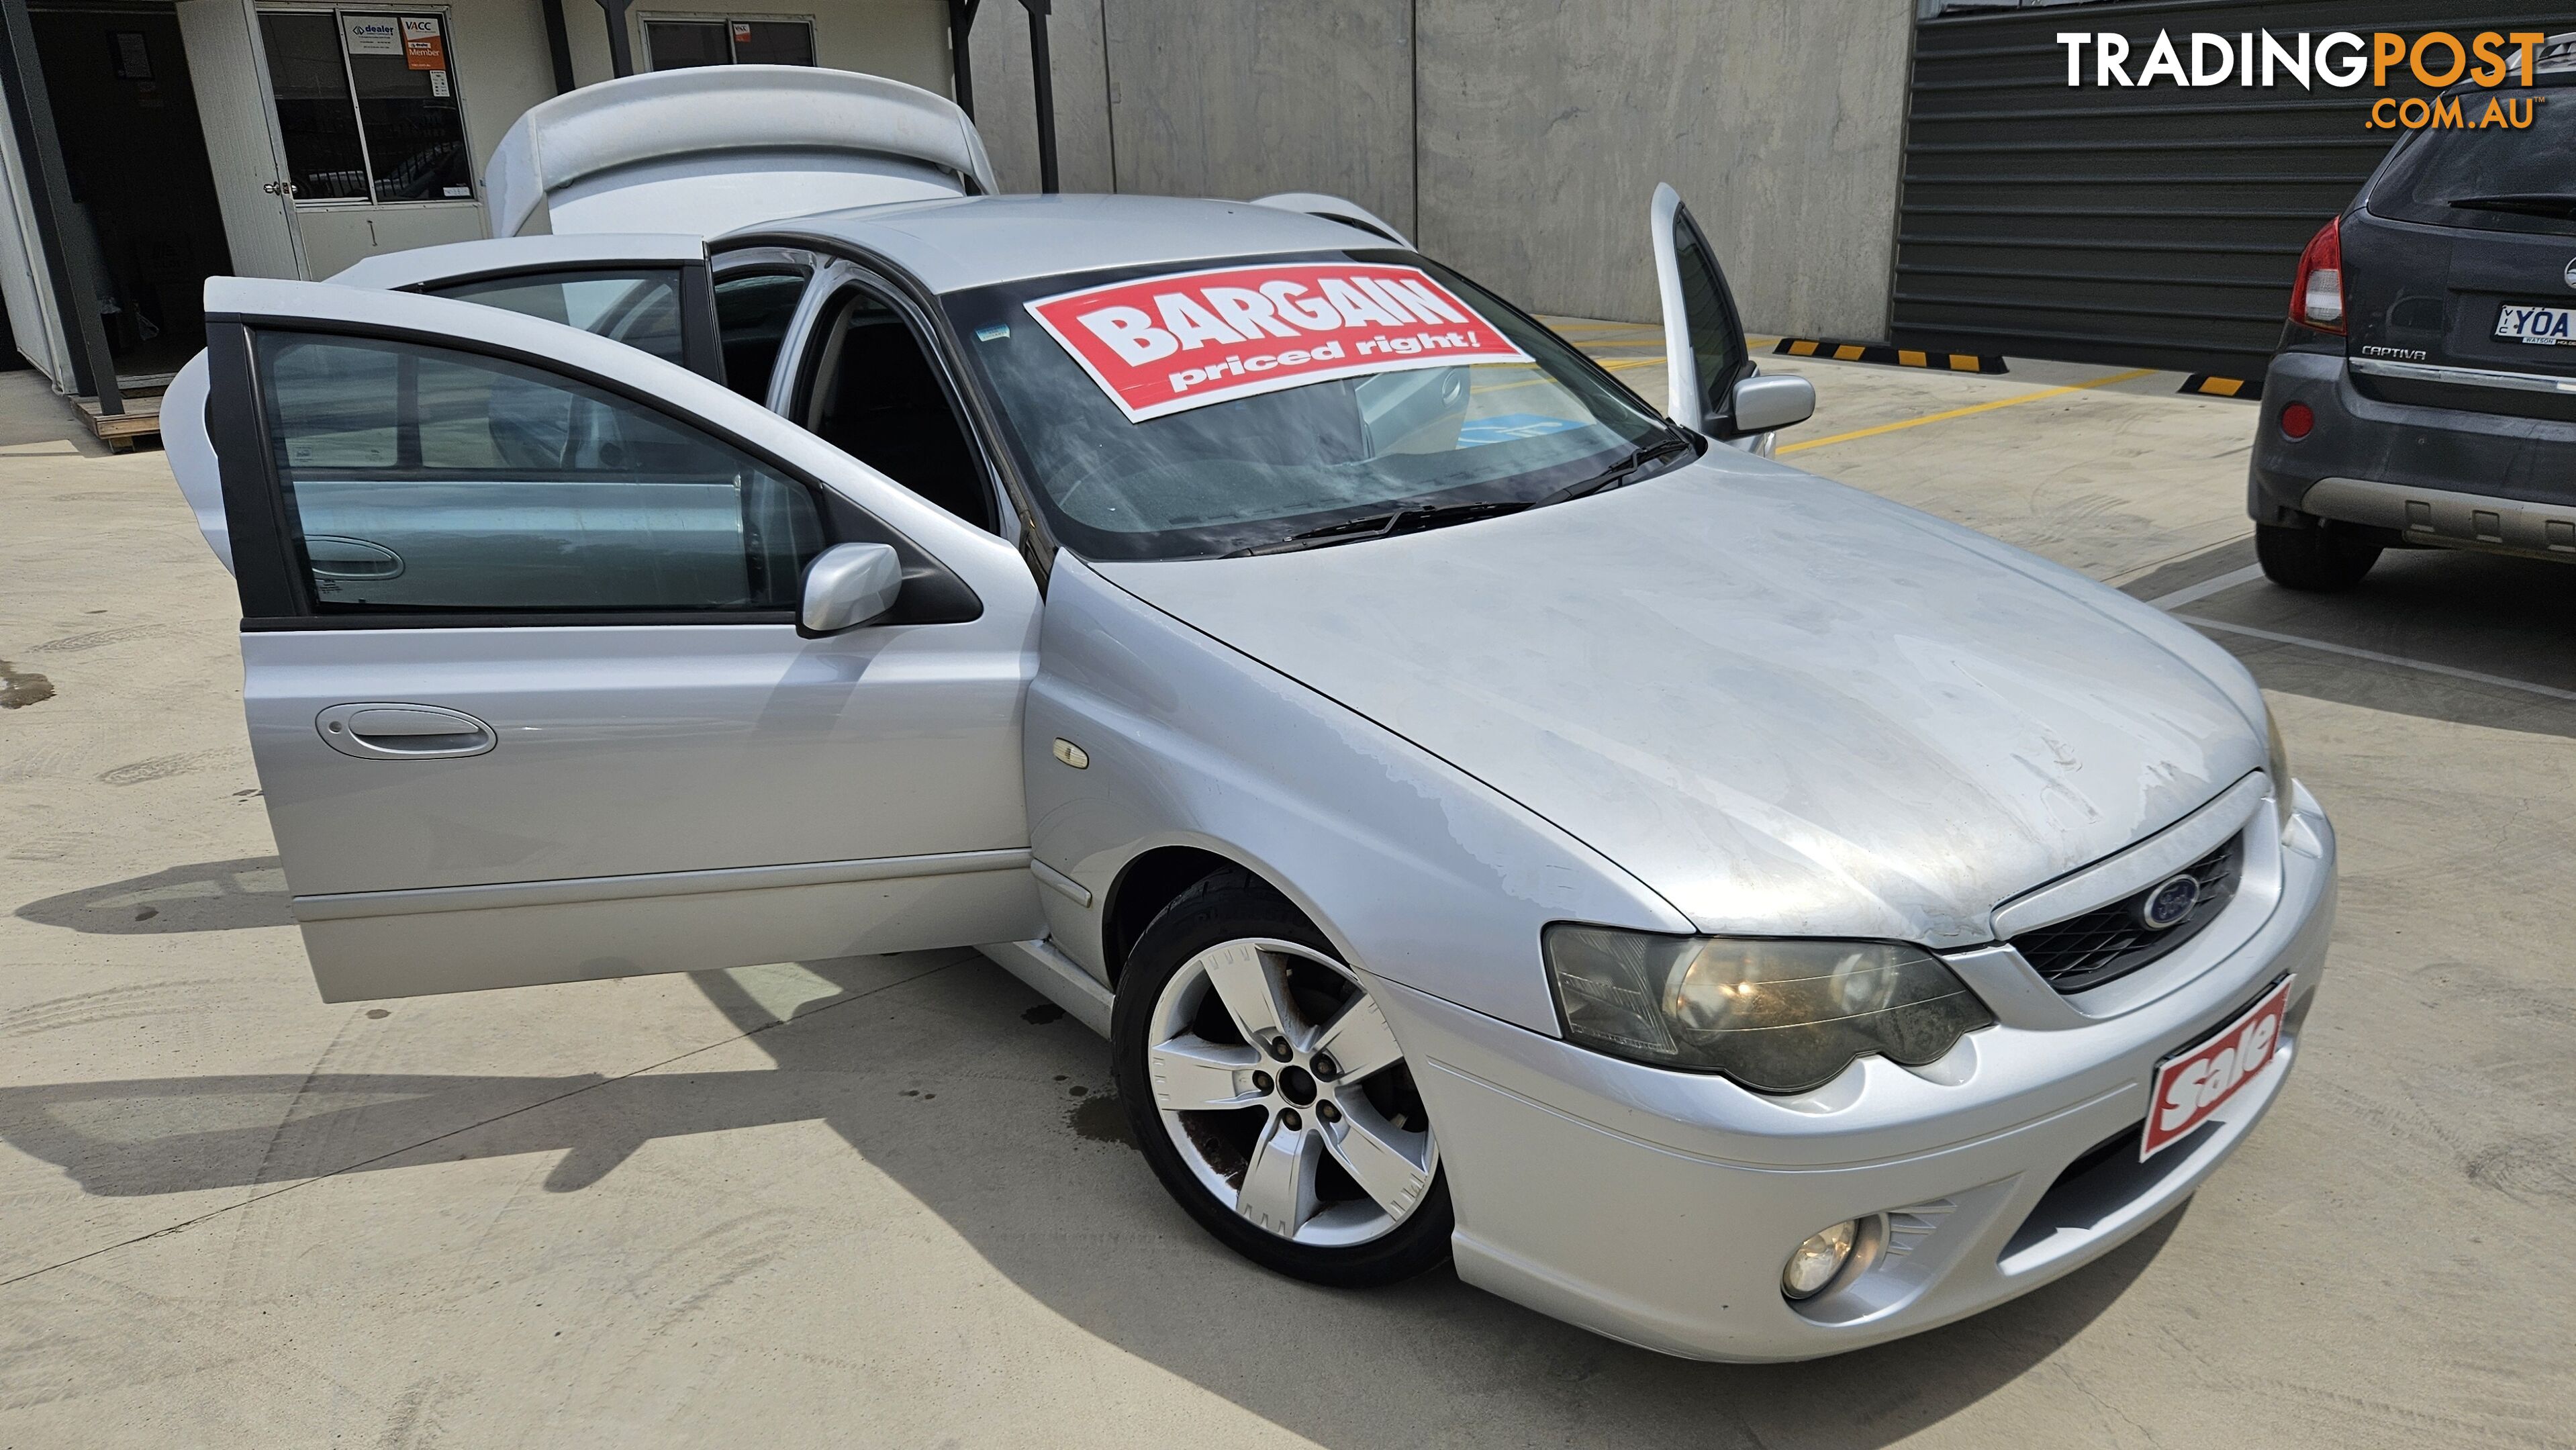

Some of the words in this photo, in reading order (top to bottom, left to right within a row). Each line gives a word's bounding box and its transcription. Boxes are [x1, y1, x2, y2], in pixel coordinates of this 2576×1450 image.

[365, 25, 393, 33] dealer
[406, 21, 431, 31] VACC
[1076, 277, 1470, 367] BARGAIN
[2516, 310, 2568, 337] YOA
[1168, 340, 1345, 393] priced
[1355, 331, 1481, 354] right!
[2362, 345, 2426, 360] CAPTIVA
[2159, 1014, 2277, 1132] Sale
